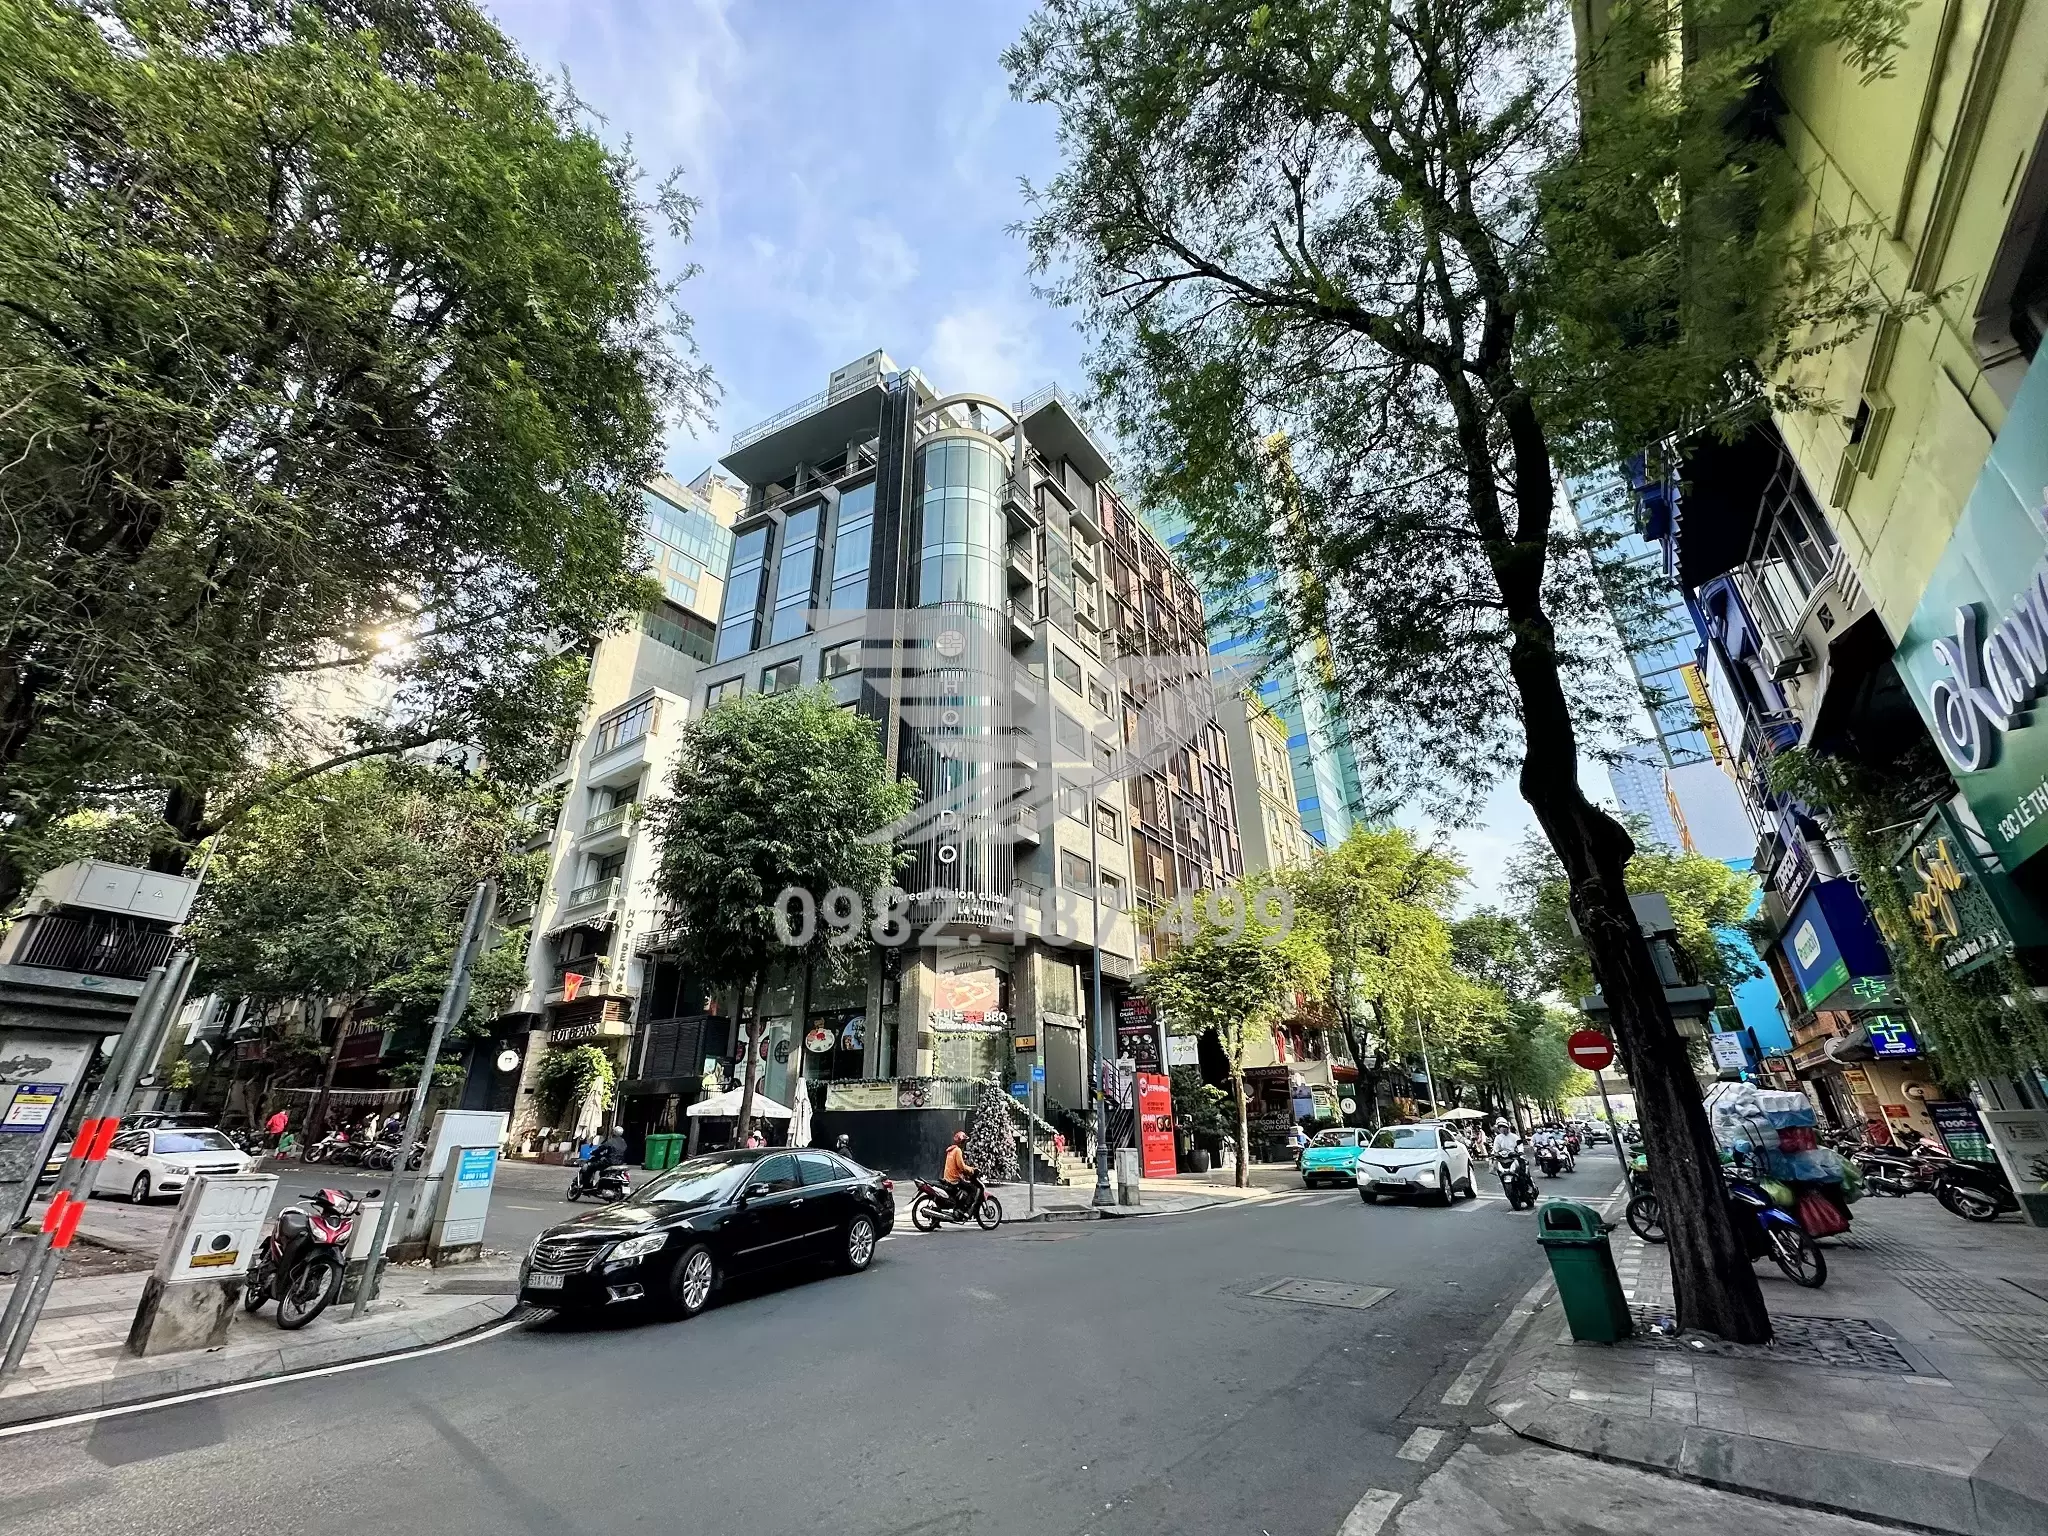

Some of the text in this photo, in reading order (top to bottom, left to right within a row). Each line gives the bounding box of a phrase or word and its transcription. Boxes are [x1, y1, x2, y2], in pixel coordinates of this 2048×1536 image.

[1997, 813, 2020, 842] 13C
[2014, 796, 2035, 828] LÊ
[616, 909, 636, 992] HOT BEANS
[984, 1011, 1008, 1025] BBQ
[551, 1027, 571, 1042] HOT
